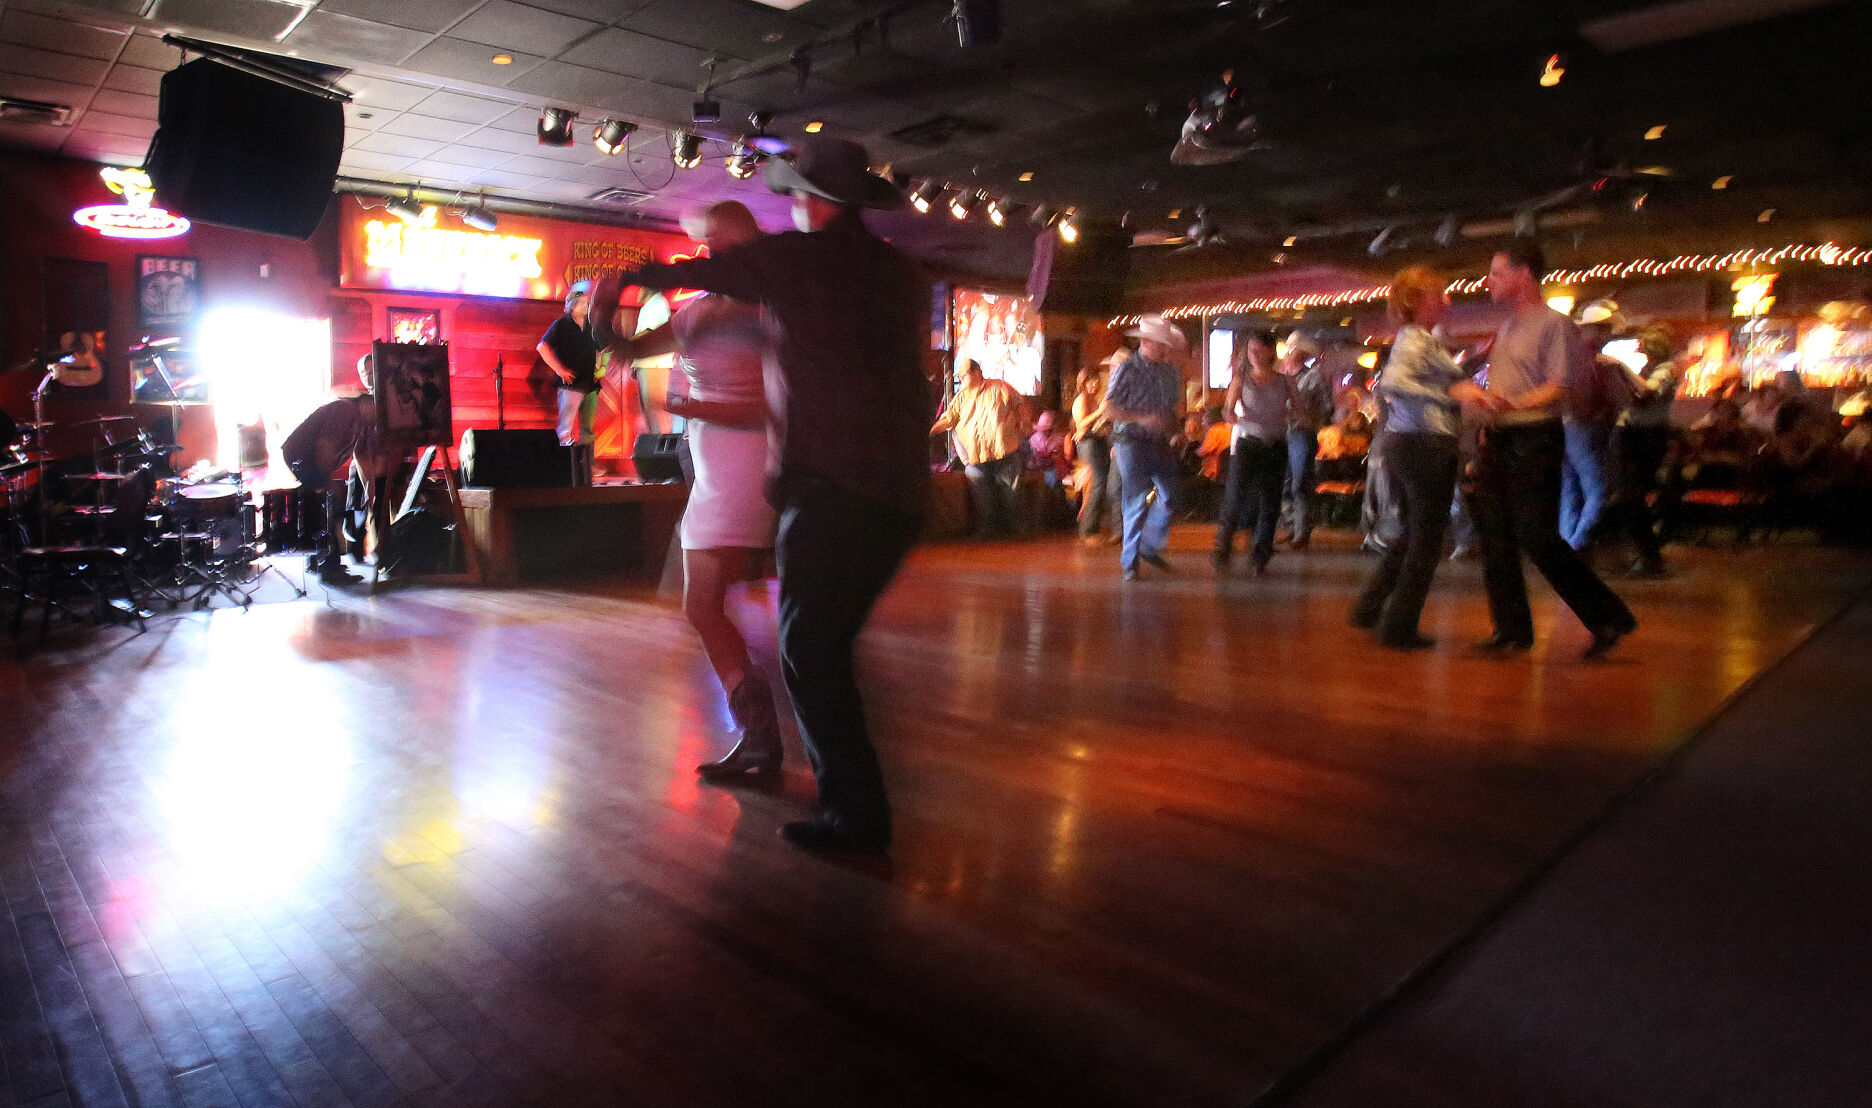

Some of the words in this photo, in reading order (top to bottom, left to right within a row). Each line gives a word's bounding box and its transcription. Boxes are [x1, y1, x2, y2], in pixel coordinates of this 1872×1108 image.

[573, 242, 599, 259] KING
[601, 242, 614, 259] OF
[616, 244, 648, 265] BEERS
[573, 263, 601, 282] KING
[601, 262, 614, 279] OF
